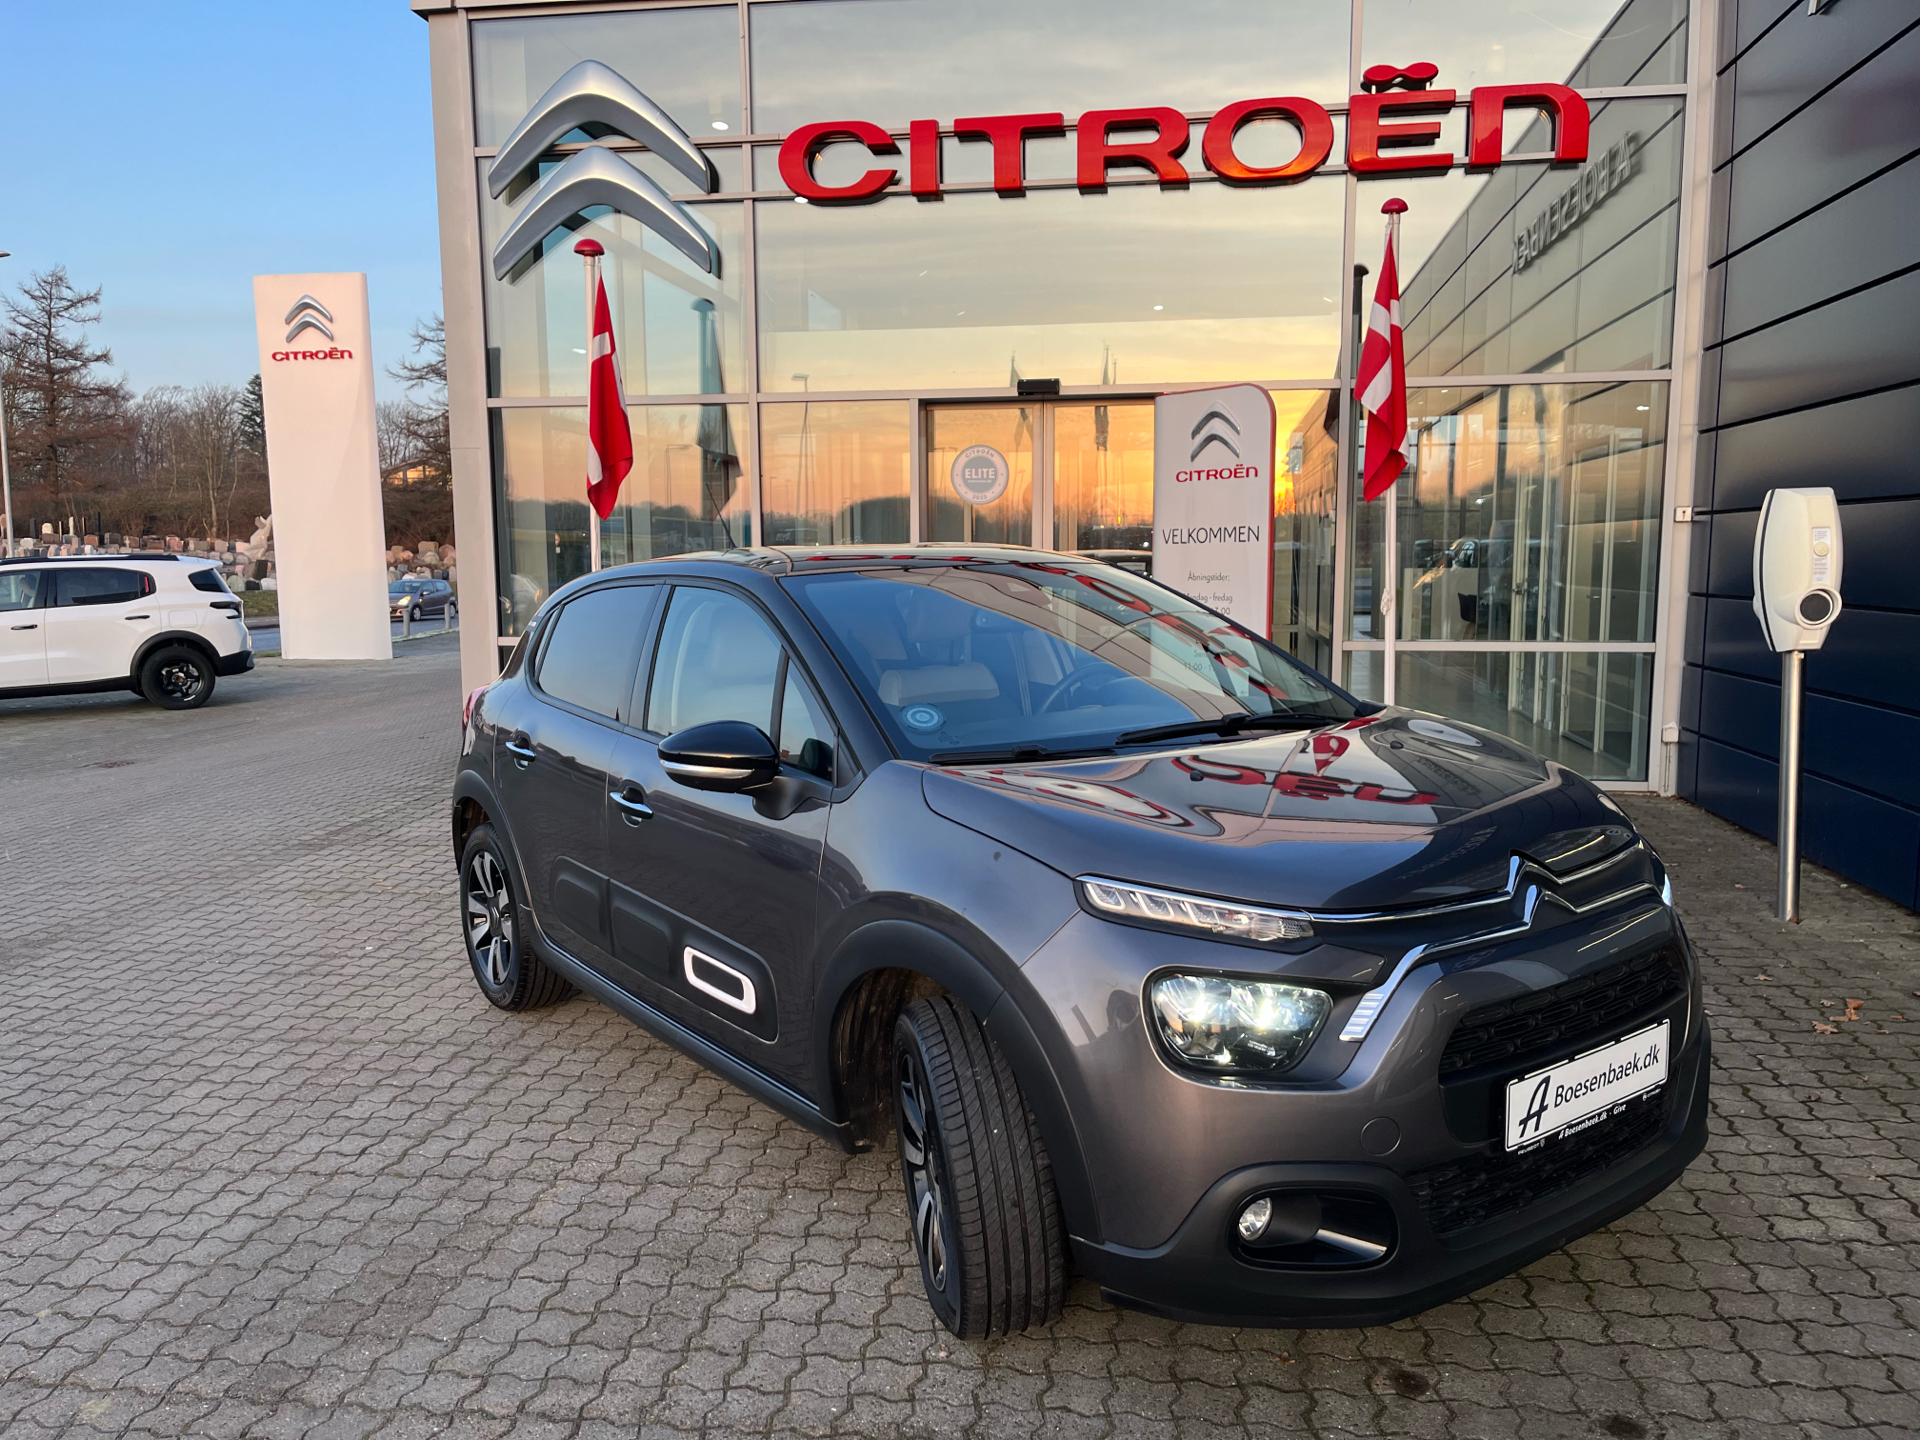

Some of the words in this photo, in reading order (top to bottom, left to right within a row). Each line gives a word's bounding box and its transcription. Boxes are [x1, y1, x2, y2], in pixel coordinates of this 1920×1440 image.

[965, 468, 995, 479] ELITE
[1162, 525, 1260, 545] VELKOMMEN
[1187, 571, 1231, 584] Åbningstider:
[1212, 592, 1233, 604] fredag
[1518, 1075, 1551, 1138] A
[1554, 1044, 1660, 1108] Boesenbaek.dk
[1564, 1112, 1608, 1137] Boesenbaek.dk
[1613, 1104, 1627, 1115] Give
